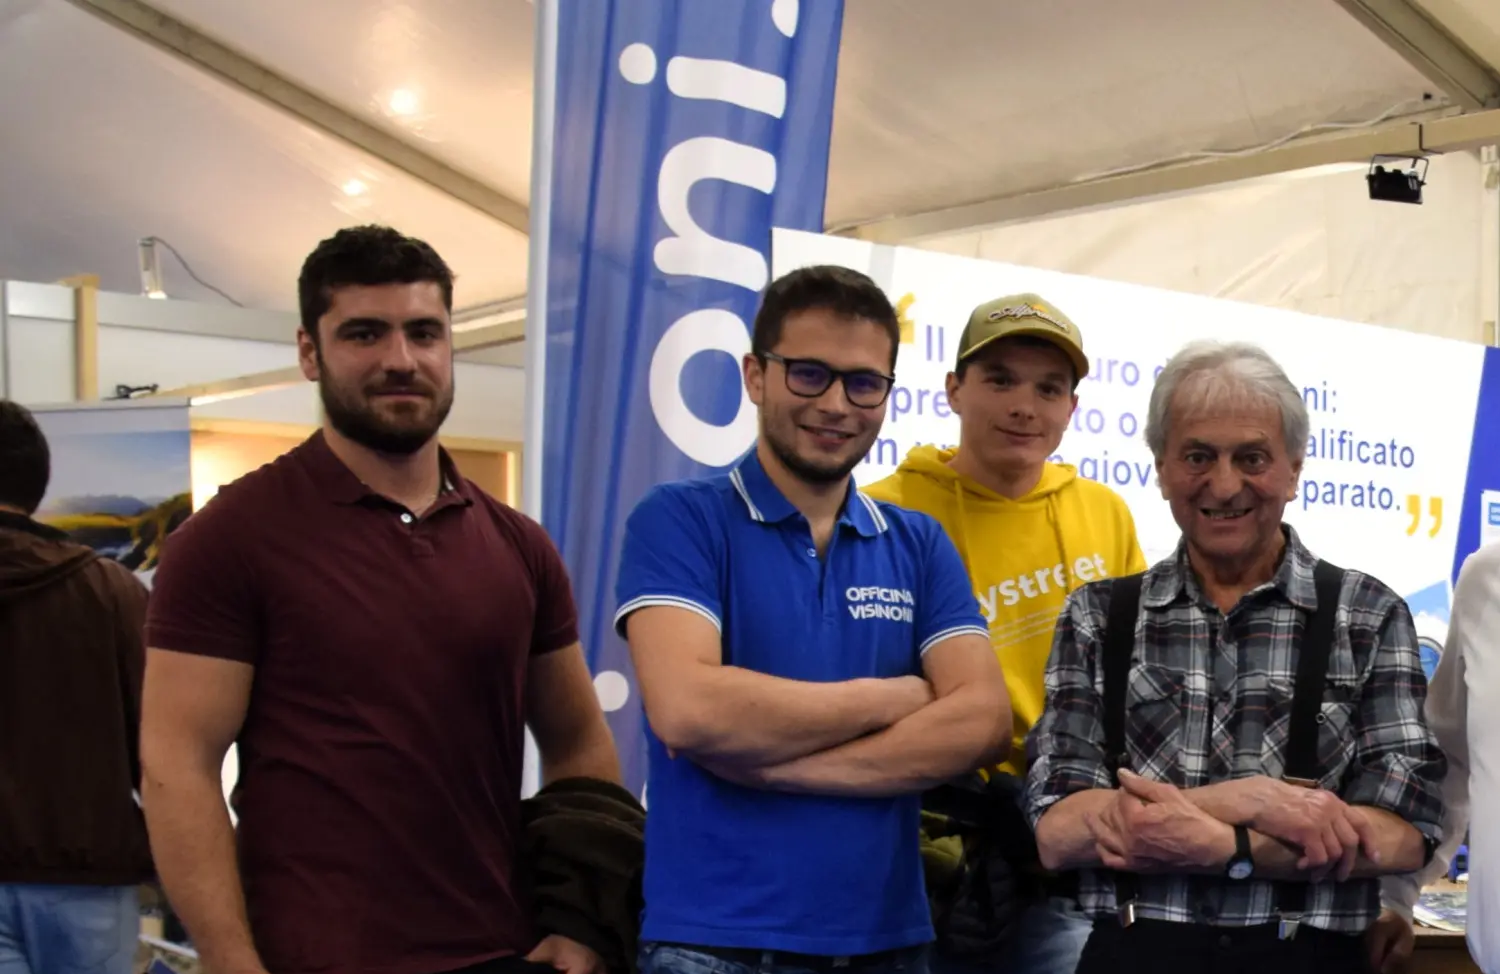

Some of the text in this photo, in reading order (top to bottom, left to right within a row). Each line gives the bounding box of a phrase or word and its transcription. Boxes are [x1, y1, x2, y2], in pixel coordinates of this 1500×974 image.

[619, 0, 798, 467] oni.
[925, 325, 944, 362] Il
[1084, 357, 1140, 386] uro
[1303, 380, 1337, 413] ni:
[1118, 412, 1138, 437] o
[1306, 427, 1415, 468] alificato
[1080, 450, 1152, 487] giov
[1303, 479, 1401, 511] parato.
[845, 586, 915, 605] OFFICINA
[976, 553, 1107, 623] ystreet
[848, 604, 914, 624] VISINONI
